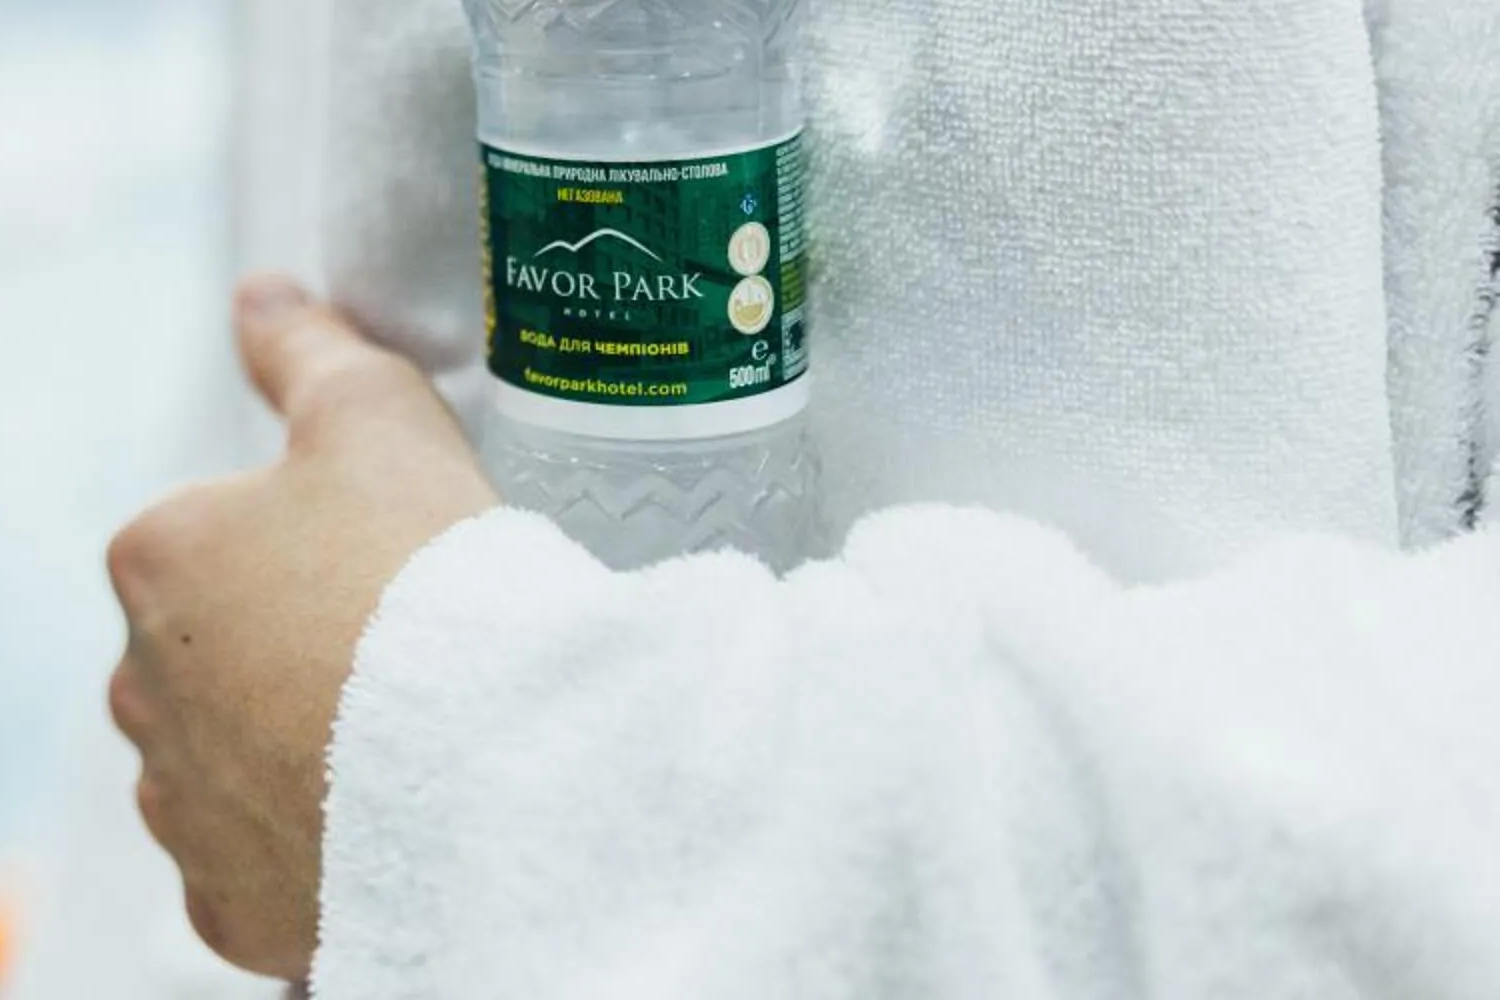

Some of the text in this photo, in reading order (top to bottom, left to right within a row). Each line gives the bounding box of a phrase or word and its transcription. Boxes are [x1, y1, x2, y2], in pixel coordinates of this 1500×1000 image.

[553, 165, 606, 183] ПРИРОДНА
[609, 162, 728, 183] ЛІКУВАЛЬНО-СТОЛОВА
[506, 256, 704, 301] FAVOR PARK
[563, 307, 631, 321] HOTEL
[520, 329, 689, 356] ВОДА ДЛЯ ЧЕМПІОНІВ
[524, 366, 688, 396] favorparkhotel.com
